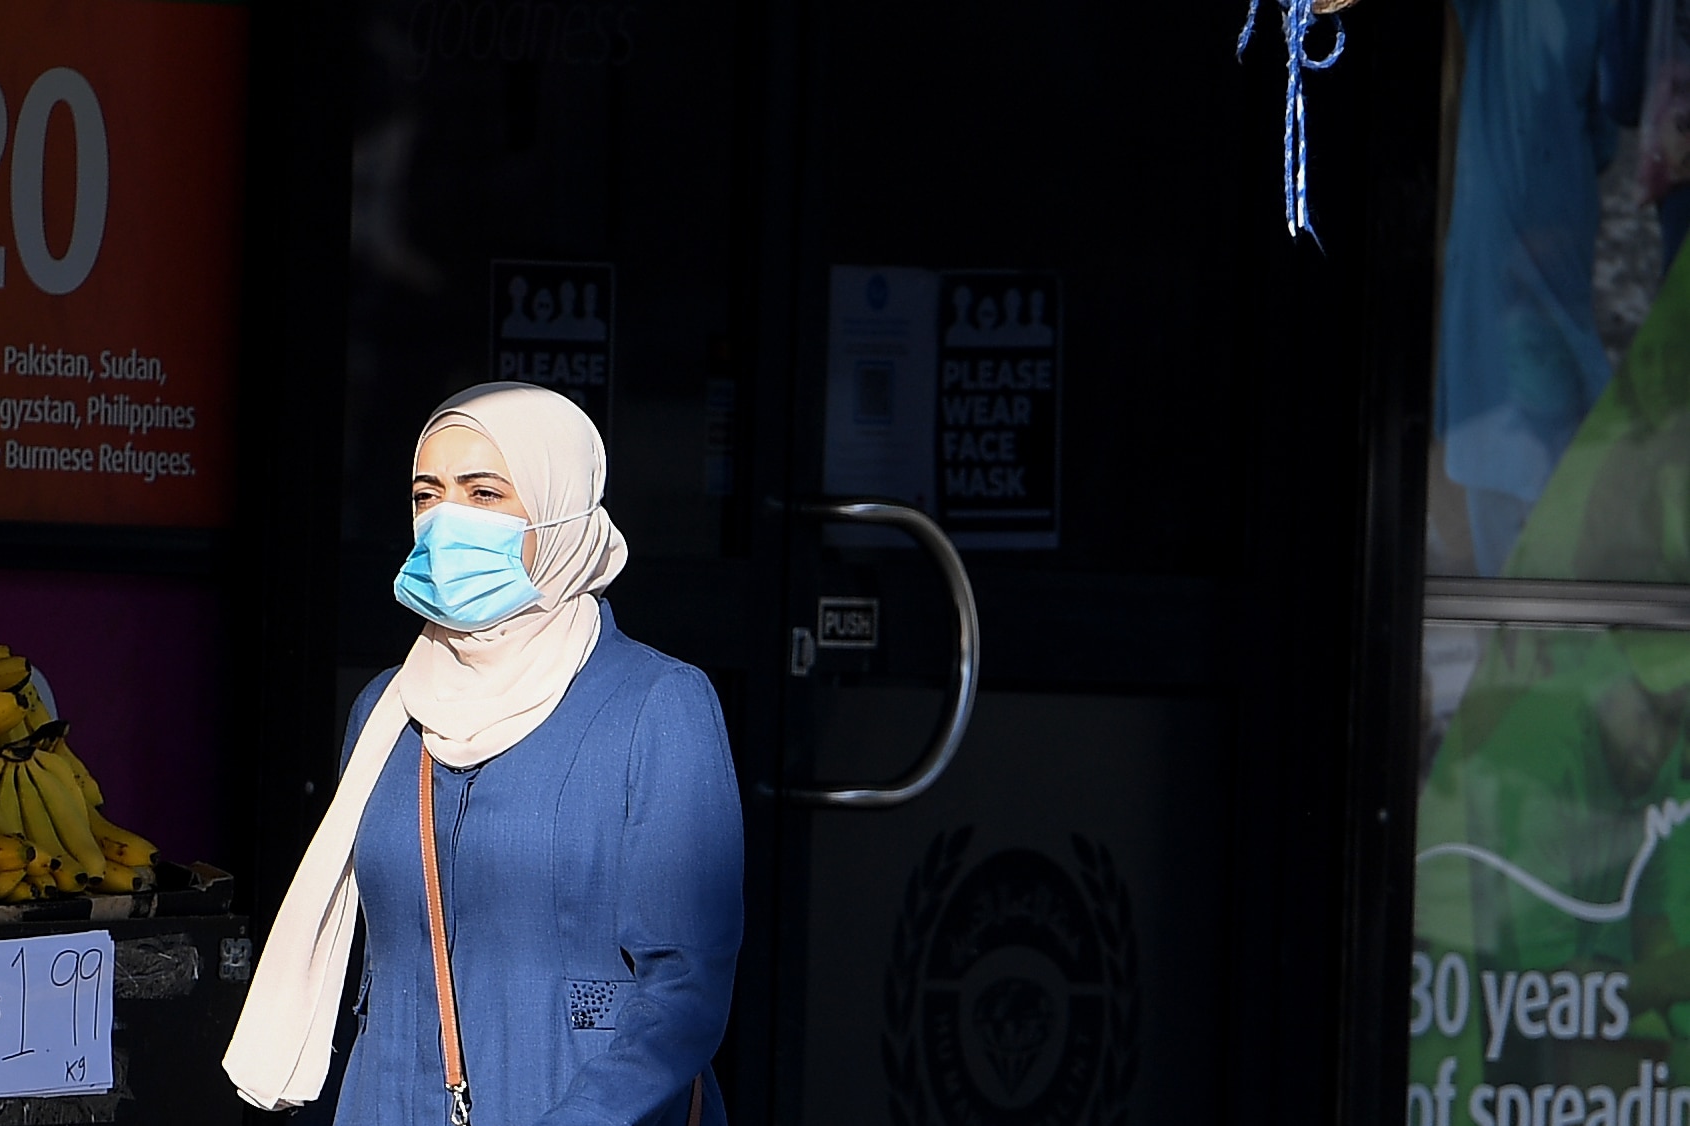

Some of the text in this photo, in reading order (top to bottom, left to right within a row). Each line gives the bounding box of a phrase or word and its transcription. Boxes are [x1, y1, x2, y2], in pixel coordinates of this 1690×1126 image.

[4, 343, 96, 384] Pakistan,
[99, 348, 168, 387] Sudan,
[499, 350, 607, 386] PLEASE
[942, 358, 1054, 392] PLEASE
[87, 393, 196, 436] Philippines
[941, 394, 1032, 428] WEAR
[5, 440, 94, 472] Burmese
[98, 442, 196, 483] Refugees.
[942, 430, 1019, 463] FACE
[943, 465, 1029, 499] MASK
[822, 609, 873, 637] PUSH
[1480, 968, 1631, 1063] years
